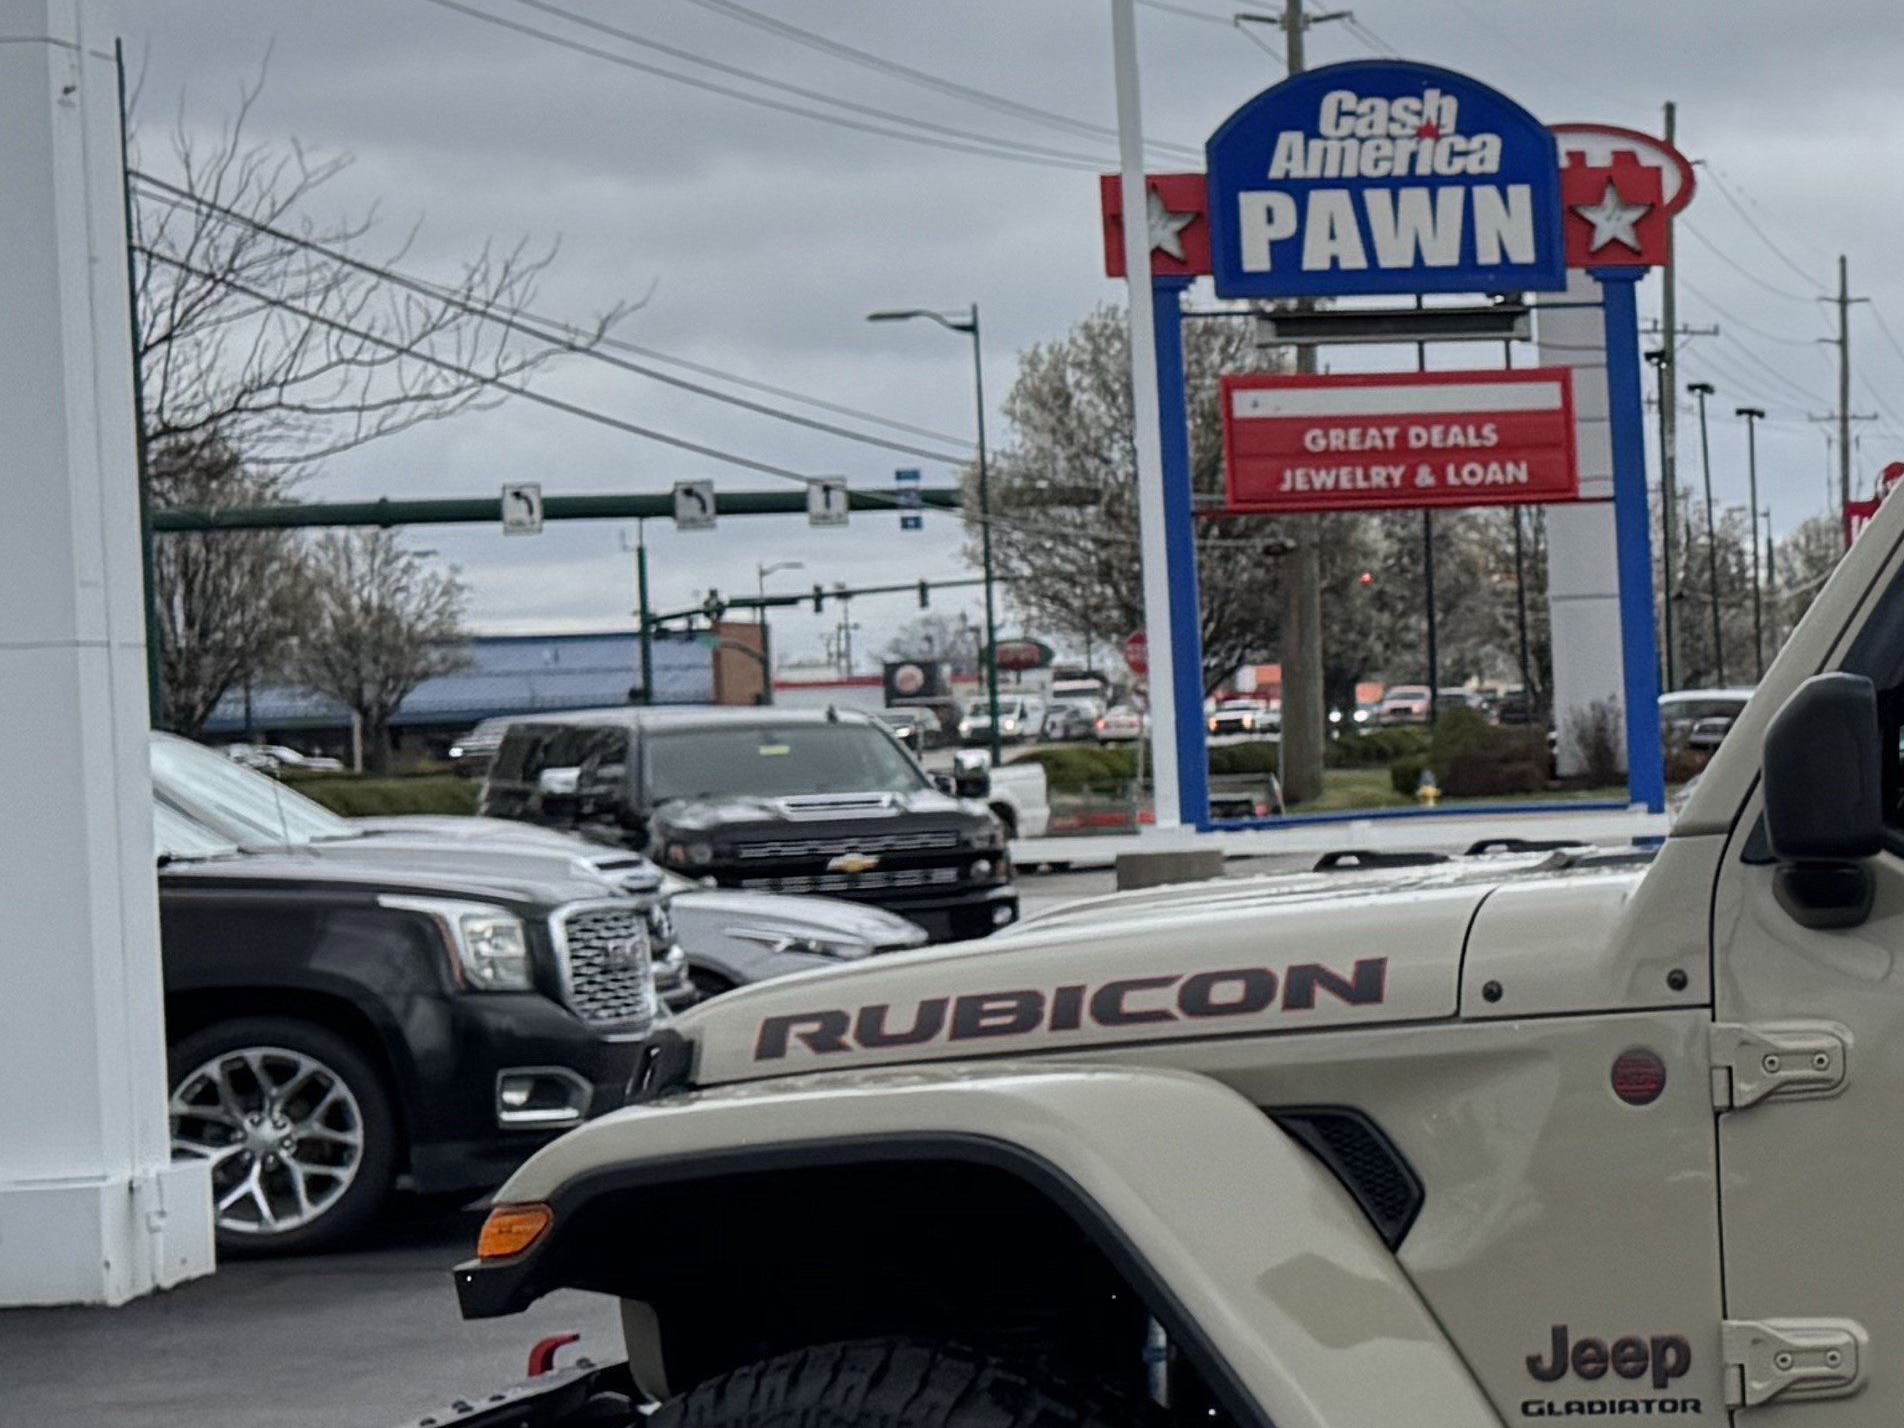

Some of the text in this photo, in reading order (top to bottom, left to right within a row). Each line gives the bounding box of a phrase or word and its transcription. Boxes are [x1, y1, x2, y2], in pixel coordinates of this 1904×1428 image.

[1319, 88, 1458, 139] Cash
[1267, 131, 1502, 179] America
[1238, 184, 1536, 272] PAWN
[1304, 423, 1498, 452] GREAT DEALS
[1280, 461, 1529, 492] JEWELRY & LOAN
[753, 956, 1389, 1062] RUBICON
[1526, 1325, 1692, 1390] Jeep
[1521, 1398, 1703, 1417] GLADIATOR
